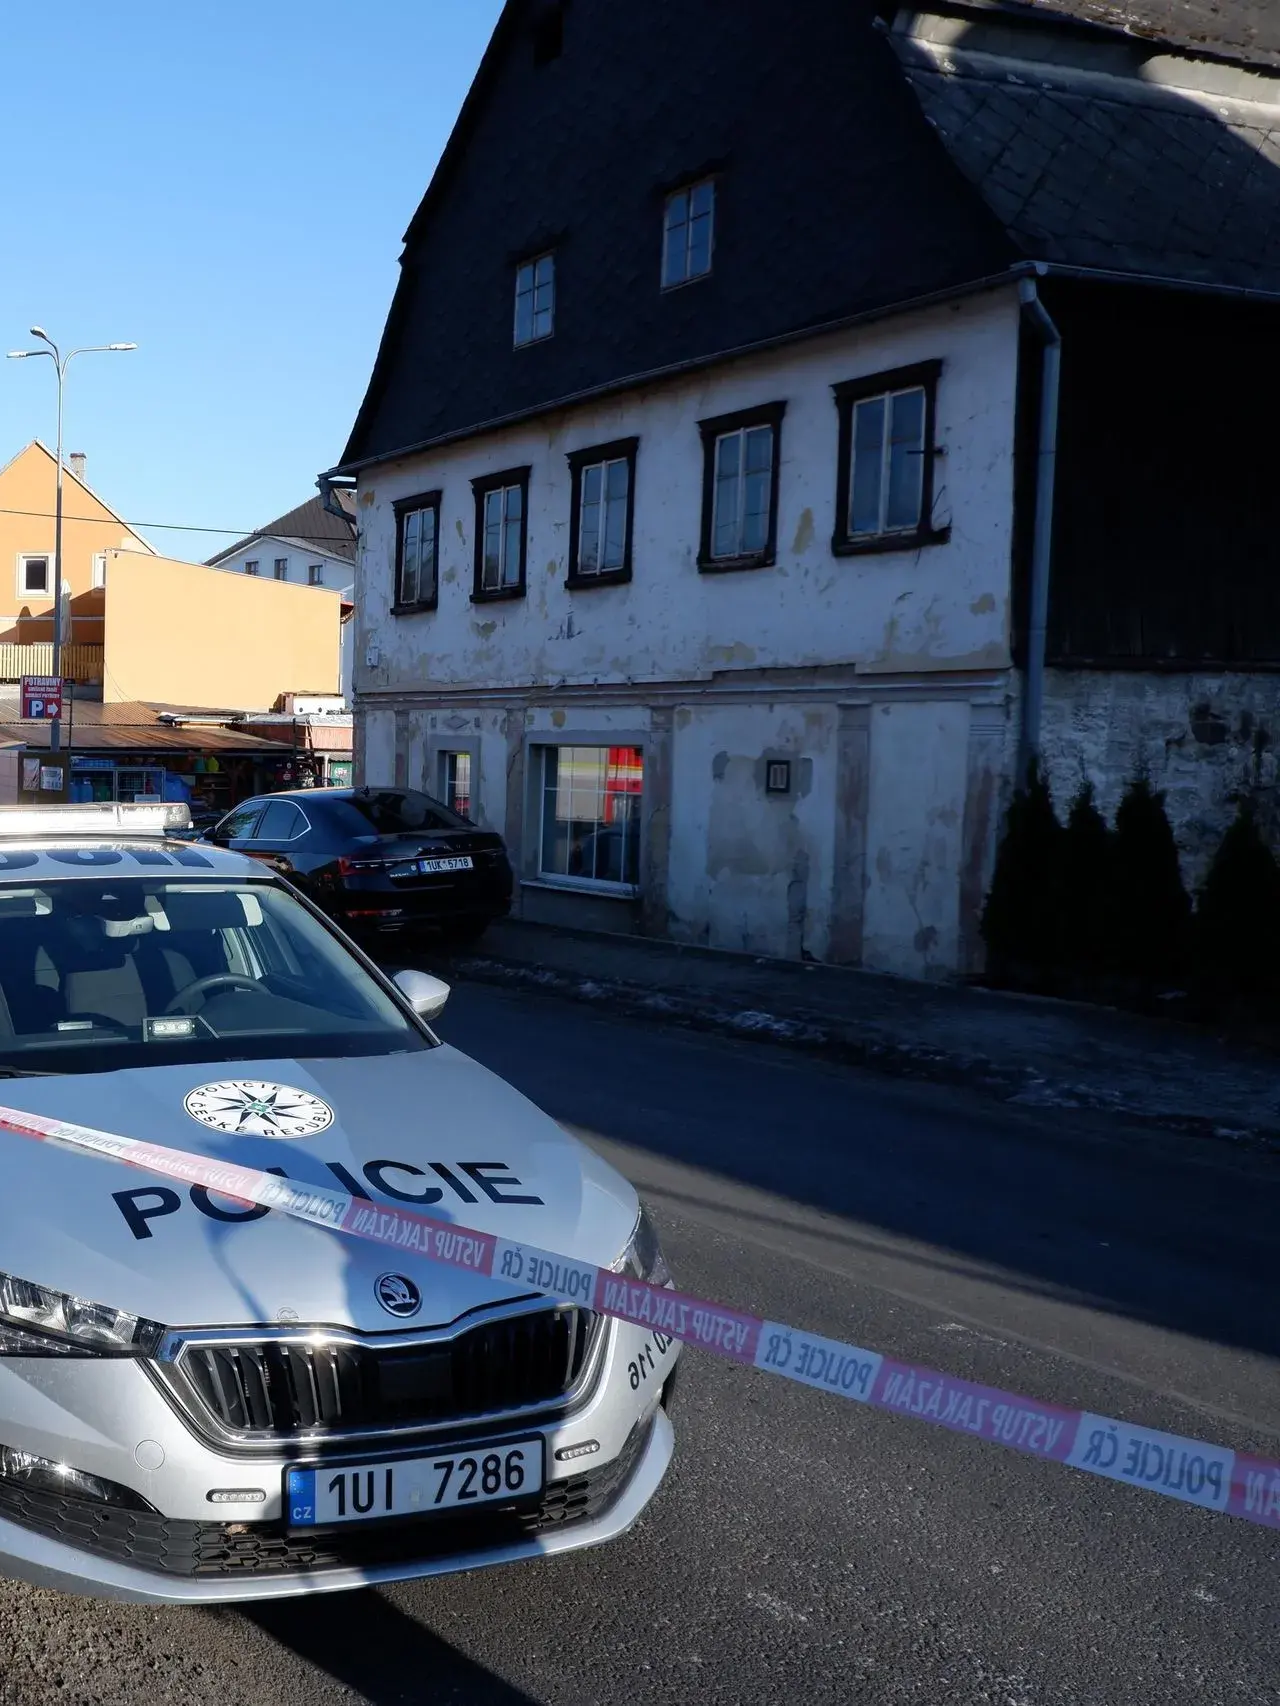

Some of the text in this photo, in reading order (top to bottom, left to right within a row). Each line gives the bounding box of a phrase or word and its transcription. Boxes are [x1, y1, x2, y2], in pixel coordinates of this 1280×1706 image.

[24, 677, 61, 686] POTRAVINY
[31, 700, 44, 717] P
[426, 857, 470, 871] 1UK 5718
[196, 1081, 282, 1098] POLICIE
[329, 1450, 525, 1516] 1UI 7286
[292, 1505, 312, 1520] CZ
